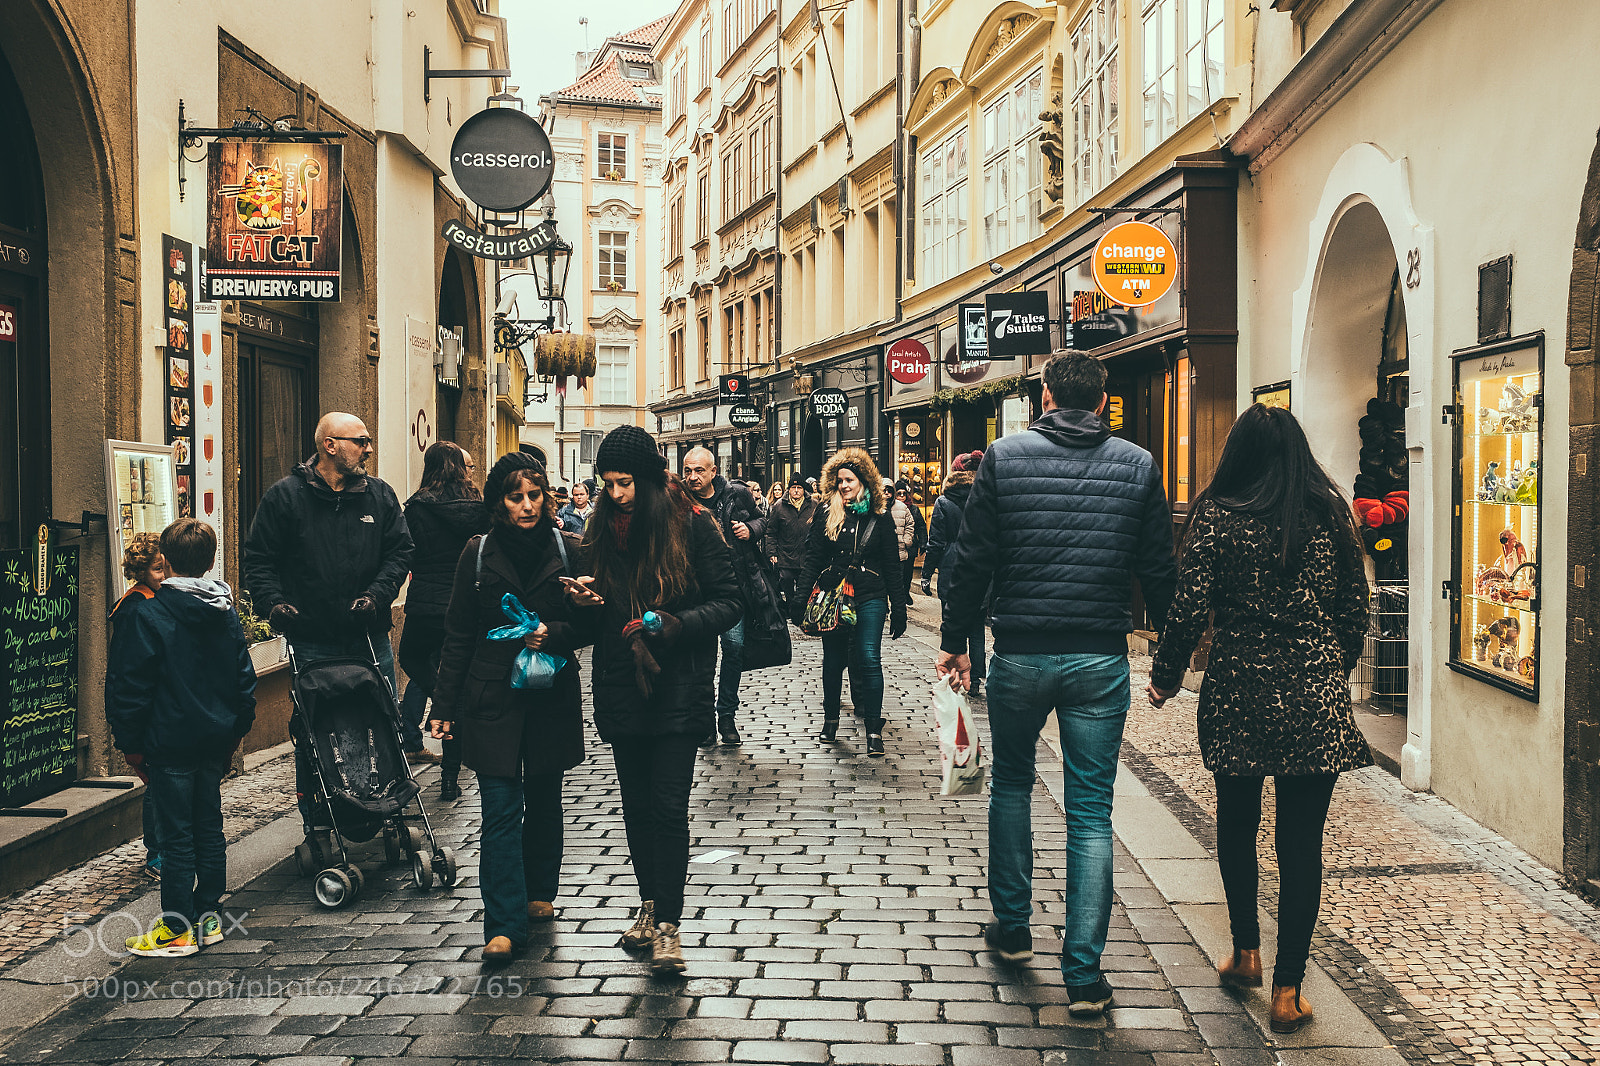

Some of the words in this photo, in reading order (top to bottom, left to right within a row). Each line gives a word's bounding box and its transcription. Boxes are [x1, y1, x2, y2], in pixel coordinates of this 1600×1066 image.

[445, 222, 552, 256] restaurant
[1102, 243, 1166, 262] change
[1406, 247, 1421, 289] 23
[1121, 279, 1151, 290] ATM
[991, 309, 1013, 339] 7
[1012, 313, 1046, 325] Tales
[1006, 322, 1044, 334] Suites
[891, 360, 931, 374] Praha
[813, 394, 846, 404] KOSTA
[816, 404, 845, 414] BODA
[15, 596, 71, 626] HUSBAND
[28, 631, 51, 646] care
